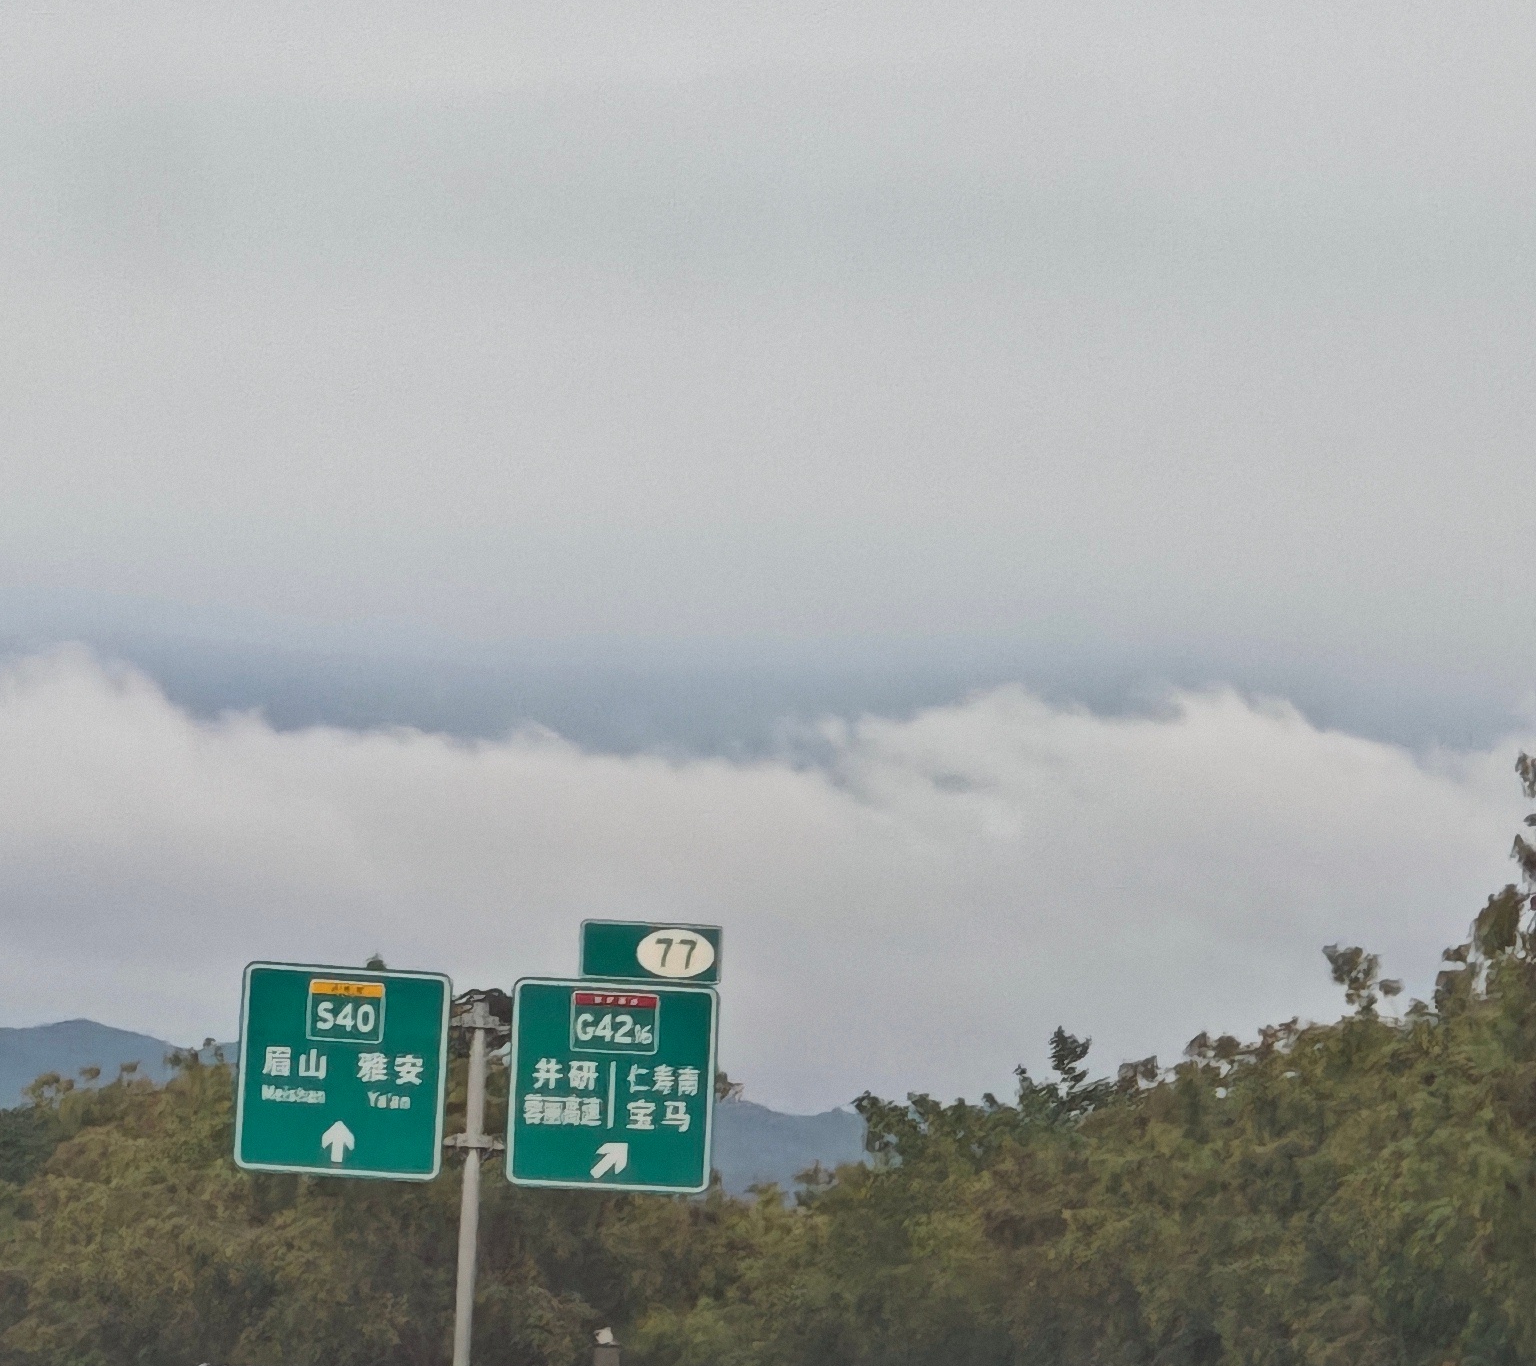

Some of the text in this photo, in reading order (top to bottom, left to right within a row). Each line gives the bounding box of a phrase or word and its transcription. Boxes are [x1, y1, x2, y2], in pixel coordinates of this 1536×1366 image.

[655, 937, 697, 971] 77
[316, 1001, 375, 1033] S40
[262, 1046, 424, 1086] 眉山 雅安
[626, 1099, 691, 1133] 宝马
